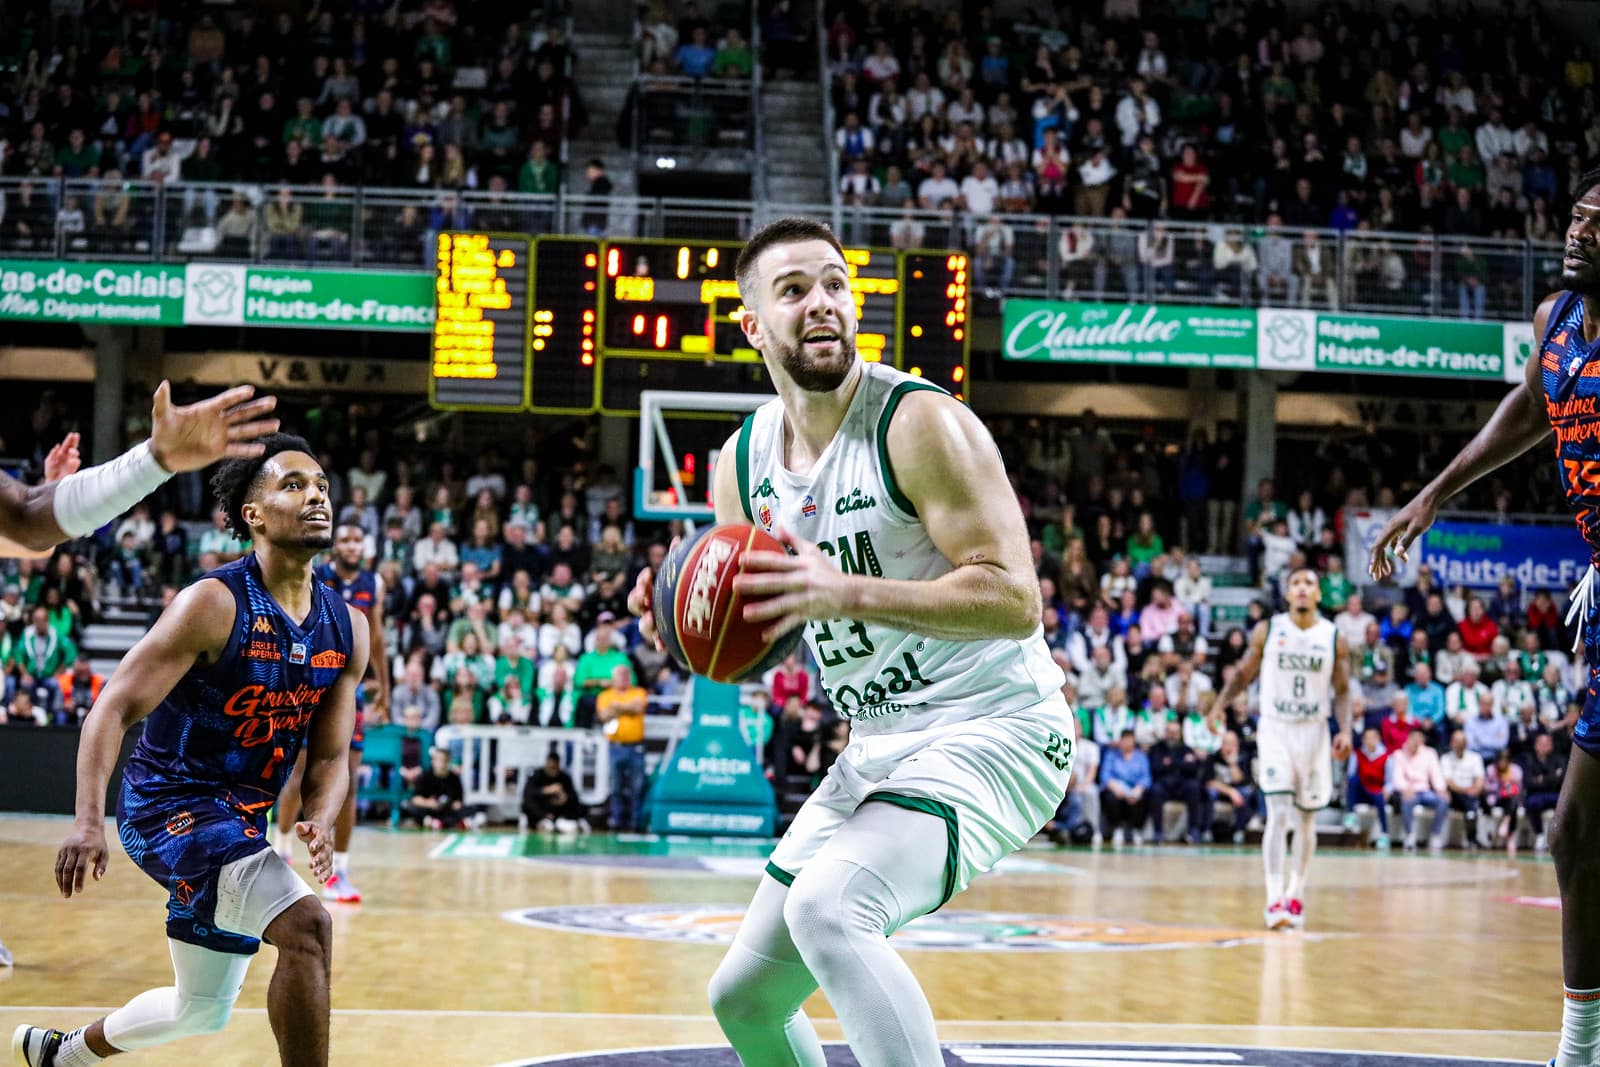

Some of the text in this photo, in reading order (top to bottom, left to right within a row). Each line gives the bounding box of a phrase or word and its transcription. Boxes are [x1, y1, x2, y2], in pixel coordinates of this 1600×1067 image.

[0, 267, 184, 299] as-de-Calais
[248, 275, 313, 296] Région
[43, 298, 161, 320] Département
[1006, 306, 1182, 359] Claudelec
[1318, 320, 1380, 341] Région
[1318, 342, 1500, 372] Hauts-de-France
[258, 361, 277, 380] V
[320, 362, 349, 383] W
[1426, 530, 1502, 554] Région
[1425, 555, 1590, 584] Hauts-de-Fr
[1278, 653, 1323, 672] ESSM
[1293, 675, 1306, 699] 8
[1043, 732, 1072, 771] 23
